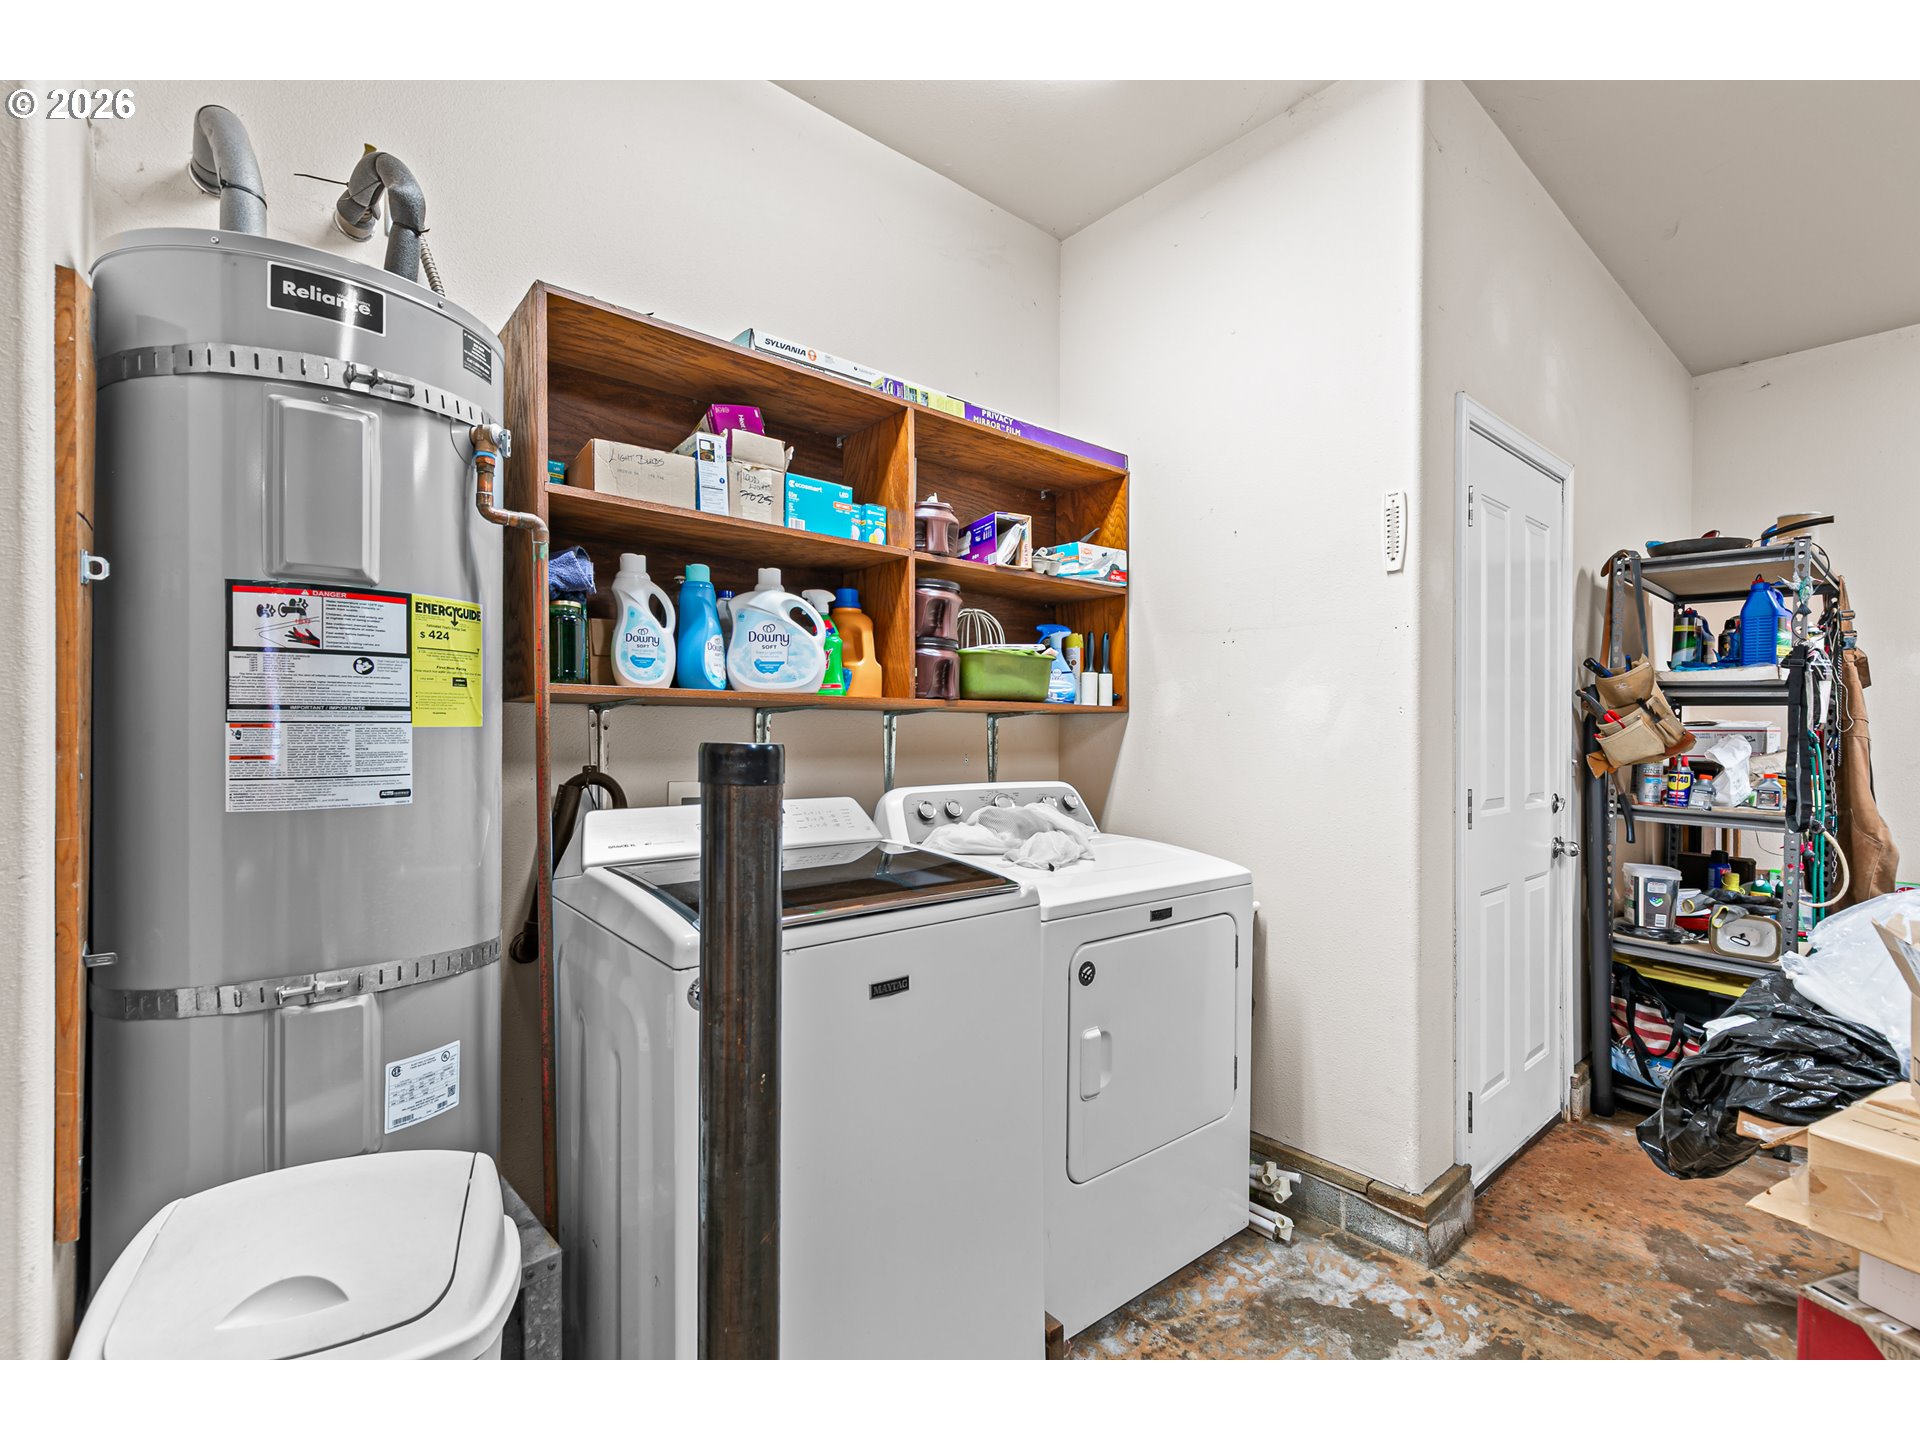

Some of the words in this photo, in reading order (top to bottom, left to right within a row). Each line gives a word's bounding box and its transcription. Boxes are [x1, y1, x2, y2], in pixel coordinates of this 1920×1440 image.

[764, 337, 806, 357] SYLVANIA
[981, 409, 1014, 426] PRIVACY
[1005, 425, 1021, 437] FILM
[312, 590, 347, 599] DANGER
[428, 630, 450, 641] 424
[625, 633, 660, 647] Downy
[748, 631, 790, 647] Downy
[872, 978, 908, 996] MAYTAG
